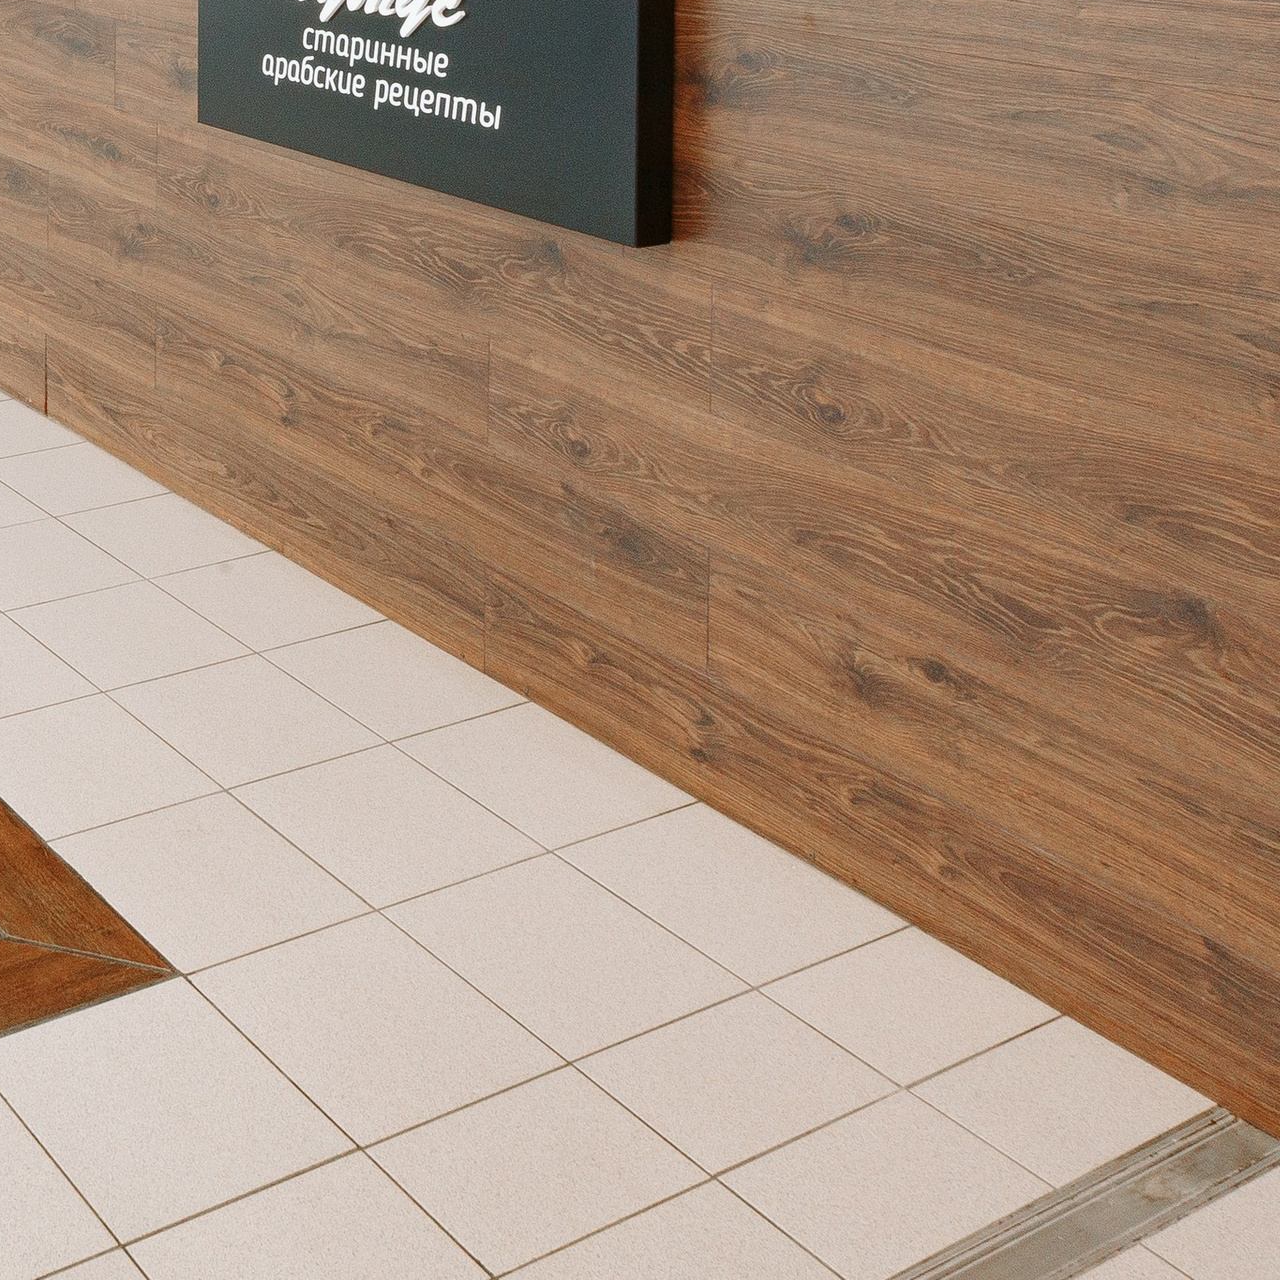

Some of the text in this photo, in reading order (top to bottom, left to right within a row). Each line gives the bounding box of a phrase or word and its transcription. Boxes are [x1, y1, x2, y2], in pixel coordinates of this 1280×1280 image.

[302, 26, 450, 78] старинные
[261, 52, 502, 131] арабские рецепты
